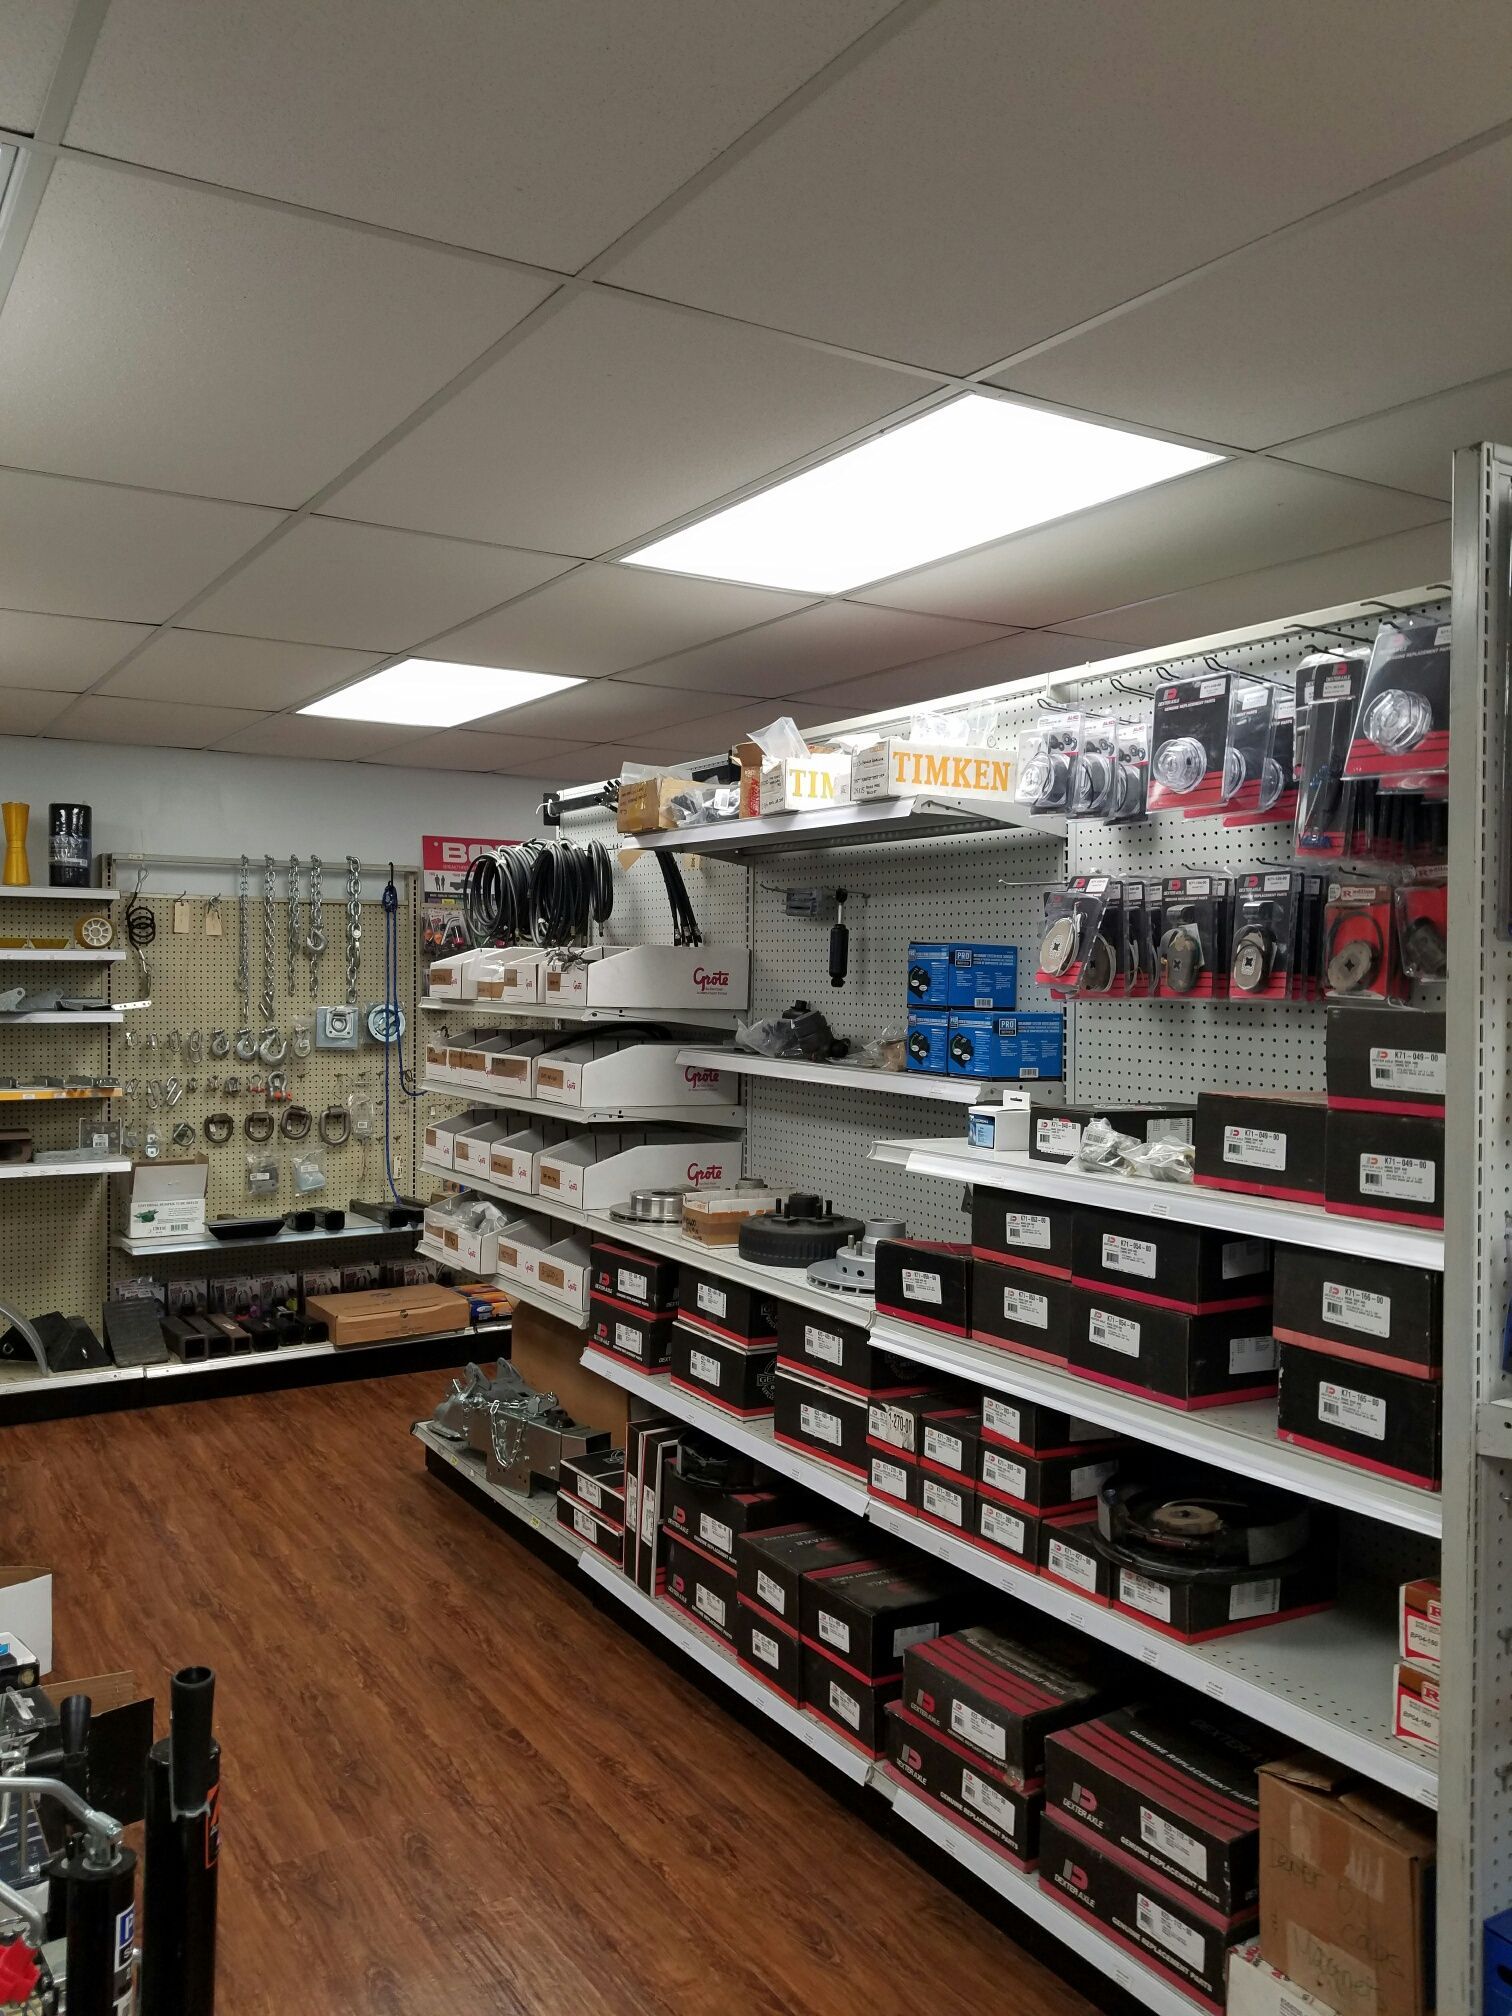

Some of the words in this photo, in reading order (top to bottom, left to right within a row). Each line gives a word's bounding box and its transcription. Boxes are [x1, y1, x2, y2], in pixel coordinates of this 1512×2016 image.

[892, 751, 1011, 792] TIMKEN
[957, 951, 970, 960] PRO
[693, 967, 729, 991] Grote
[1001, 1020, 1015, 1028] PRO
[1394, 1051, 1439, 1063] K71-049-00
[684, 1065, 720, 1088] Grote
[687, 1162, 722, 1187] Grote
[1384, 1157, 1427, 1169] K71-049-00
[1344, 1288, 1384, 1305] K71-166-00
[913, 1771, 928, 1786] AXLE
[1129, 1730, 1169, 1755] GENUINE
[1166, 1753, 1232, 1791] REPLACEMENT
[1229, 1790, 1260, 1806] PARTS
[939, 1791, 964, 1811] GENUINE
[963, 1806, 1002, 1838] REPLACEMENT
[1001, 1832, 1019, 1850] PARTS
[1063, 1797, 1088, 1820] DEXTER
[1086, 1813, 1105, 1830] AXLE
[1120, 1836, 1150, 1859] GENUINE
[1149, 1854, 1197, 1888] REPLACEMENT
[1197, 1885, 1221, 1903] PARTS
[1054, 1873, 1079, 1896] DEXTER
[1077, 1891, 1096, 1909] AXLE
[1111, 1916, 1141, 1941] GENUINE
[1141, 1937, 1190, 1975] REPLACEMENT
[1189, 1972, 1213, 1993] PARTS
